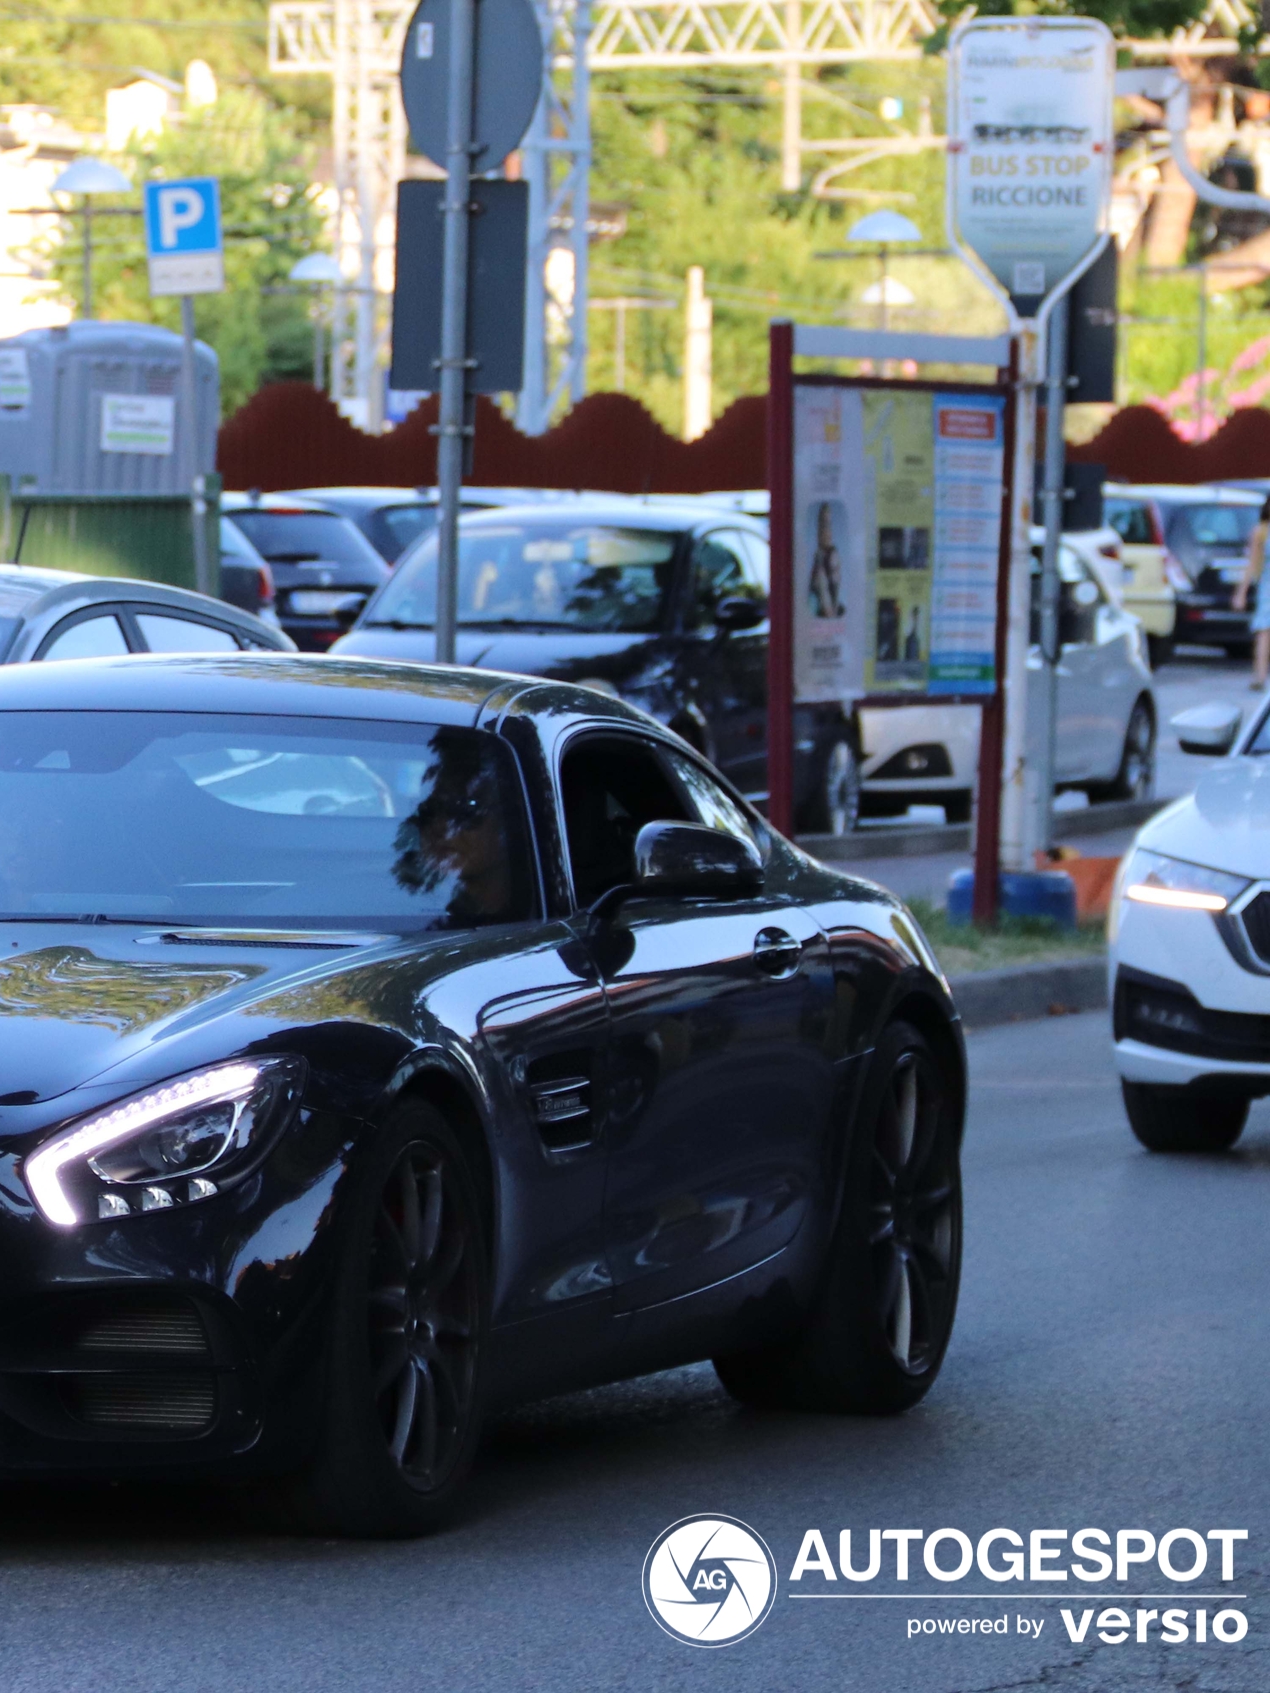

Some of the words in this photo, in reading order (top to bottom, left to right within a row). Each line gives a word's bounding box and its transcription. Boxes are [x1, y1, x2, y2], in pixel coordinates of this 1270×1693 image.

[970, 155, 1018, 176] BUS
[1026, 155, 1091, 176] STOP
[971, 186, 1087, 206] RICCIONE
[159, 188, 204, 248] P
